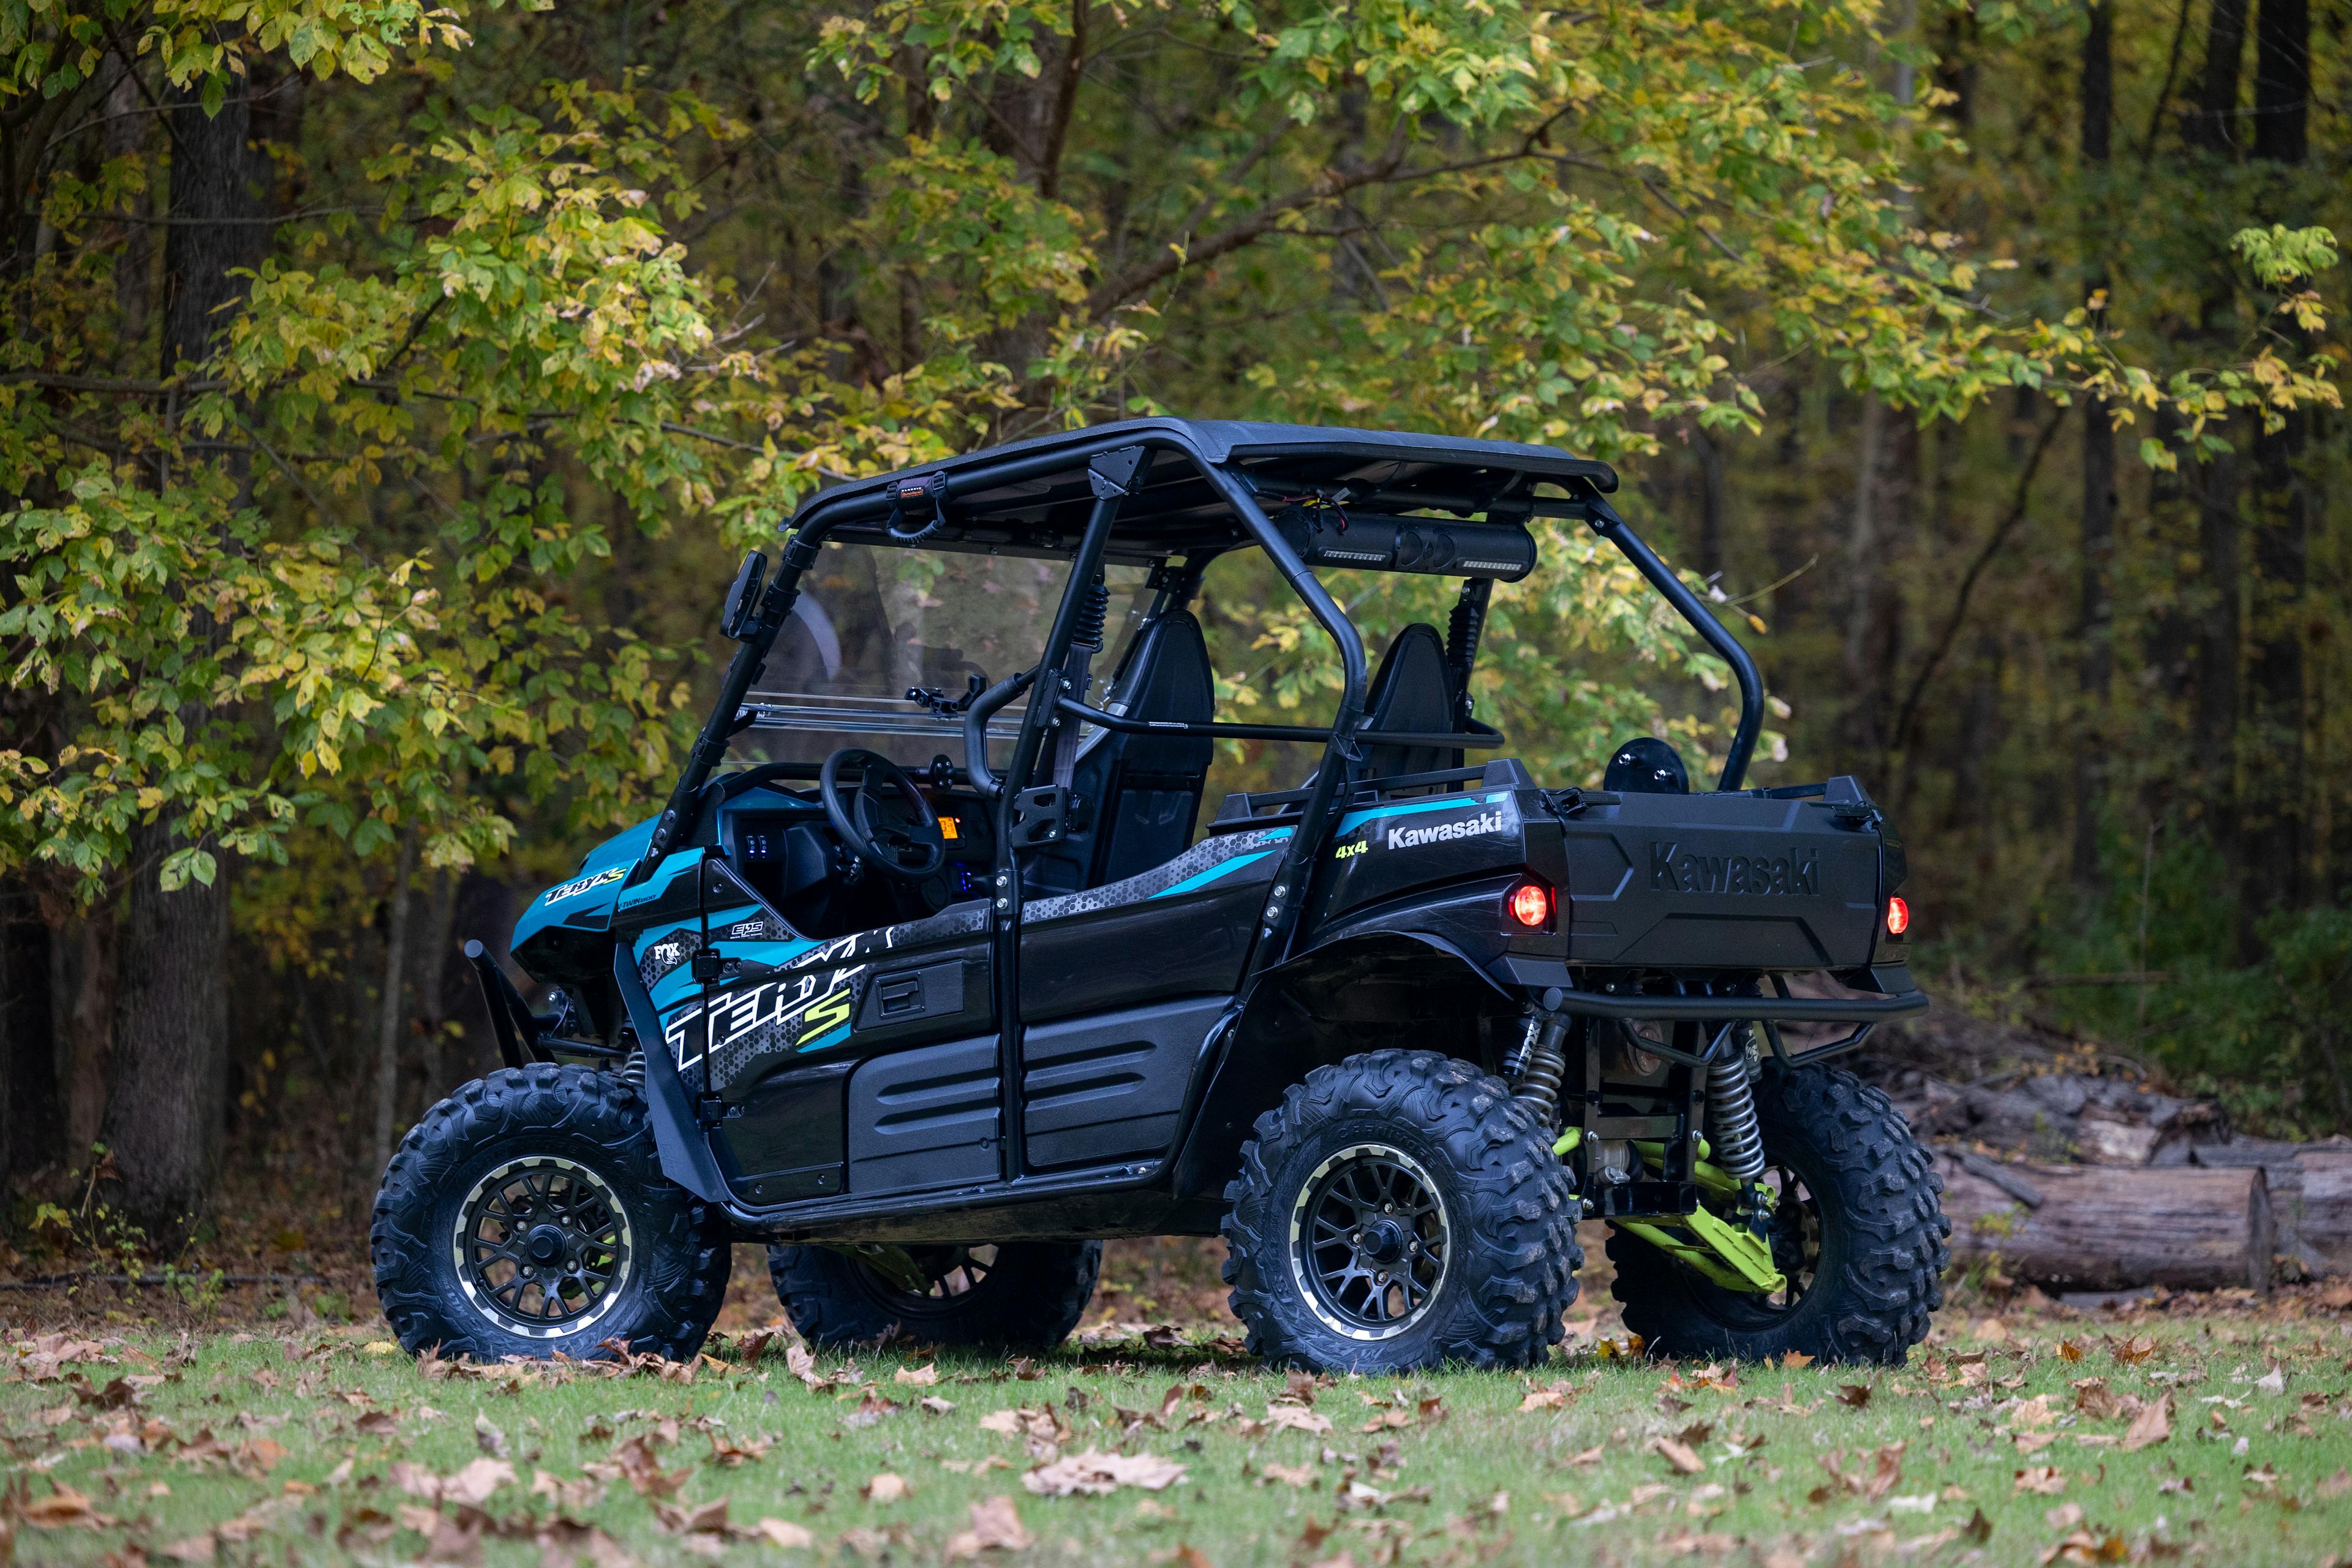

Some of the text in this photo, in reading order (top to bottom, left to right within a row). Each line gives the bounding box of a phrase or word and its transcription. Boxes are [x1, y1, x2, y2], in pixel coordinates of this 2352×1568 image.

[1388, 810, 1502, 850] Kawasaki
[1335, 840, 1368, 859] 4x4
[1649, 842, 1819, 895] Kawasaki
[731, 921, 763, 935] EPS
[654, 943, 680, 965] FOX
